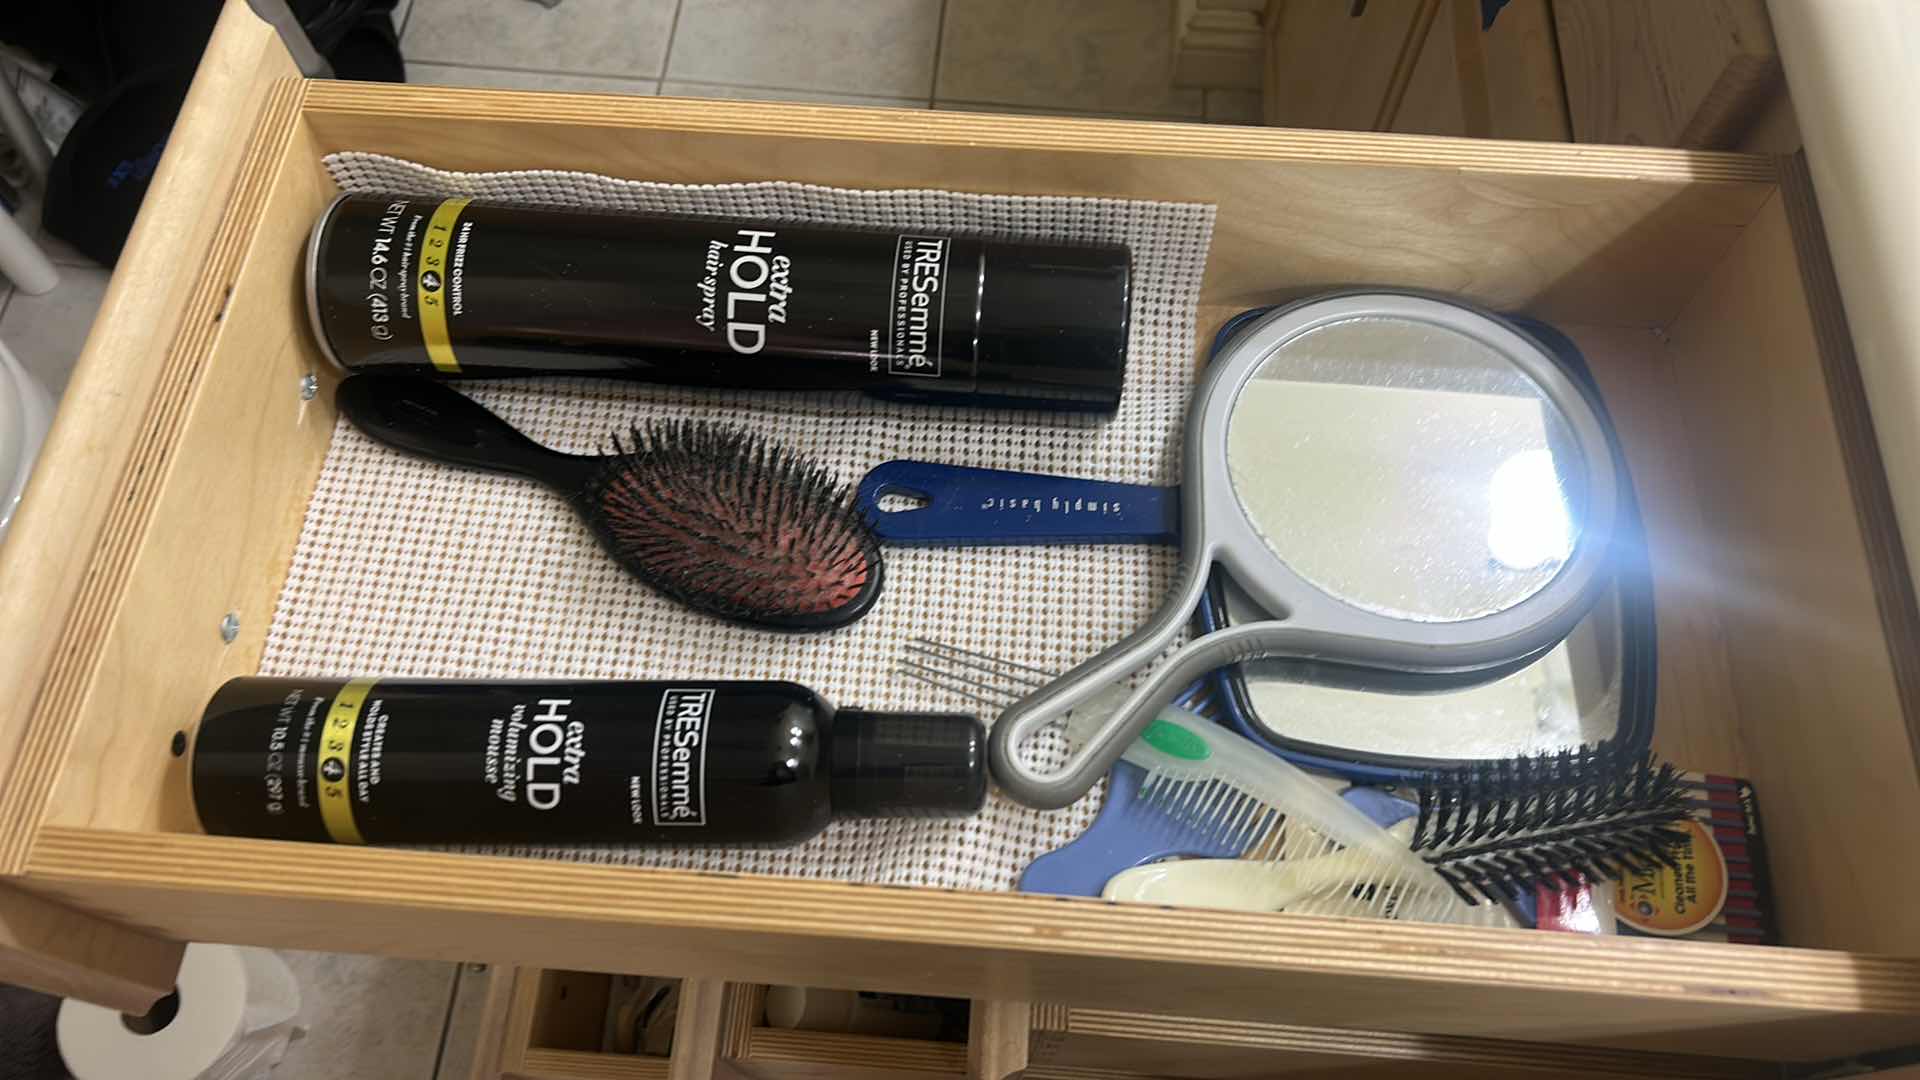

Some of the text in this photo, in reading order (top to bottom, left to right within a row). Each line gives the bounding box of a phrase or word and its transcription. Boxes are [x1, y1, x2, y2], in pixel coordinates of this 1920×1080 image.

[378, 216, 399, 234] WT
[434, 224, 448, 232] 1
[458, 232, 470, 243] HR
[371, 237, 392, 265] 14.6
[430, 238, 443, 248] 2
[454, 244, 467, 267] FRIZZ
[425, 256, 440, 266] 3
[369, 267, 388, 290] OZ
[726, 229, 776, 354] HOLD
[767, 255, 793, 323] extra
[424, 295, 438, 307] 5
[452, 268, 463, 316] CONTROL
[895, 241, 913, 366] USED BY PROFESSIONALS
[908, 239, 942, 368] TRESemmé
[366, 293, 390, 323] (413
[869, 329, 879, 372] NEW LOOK
[985, 496, 1121, 514] simply basic
[334, 718, 350, 729] 2
[269, 726, 289, 751] 10.5
[328, 740, 344, 752] 3
[369, 714, 389, 785] CREATES AND
[484, 718, 505, 785] mousse
[267, 752, 283, 772] OZ
[496, 704, 528, 802] volumizing
[526, 698, 571, 810] HOLD
[562, 721, 586, 785] extra
[658, 694, 678, 818] USED BY PROFESSIONALS
[671, 692, 706, 818] TRESemmé
[357, 760, 368, 781] ALL
[325, 786, 342, 799] 5
[358, 781, 369, 802] DAY
[630, 775, 642, 825] NEW LOOK
